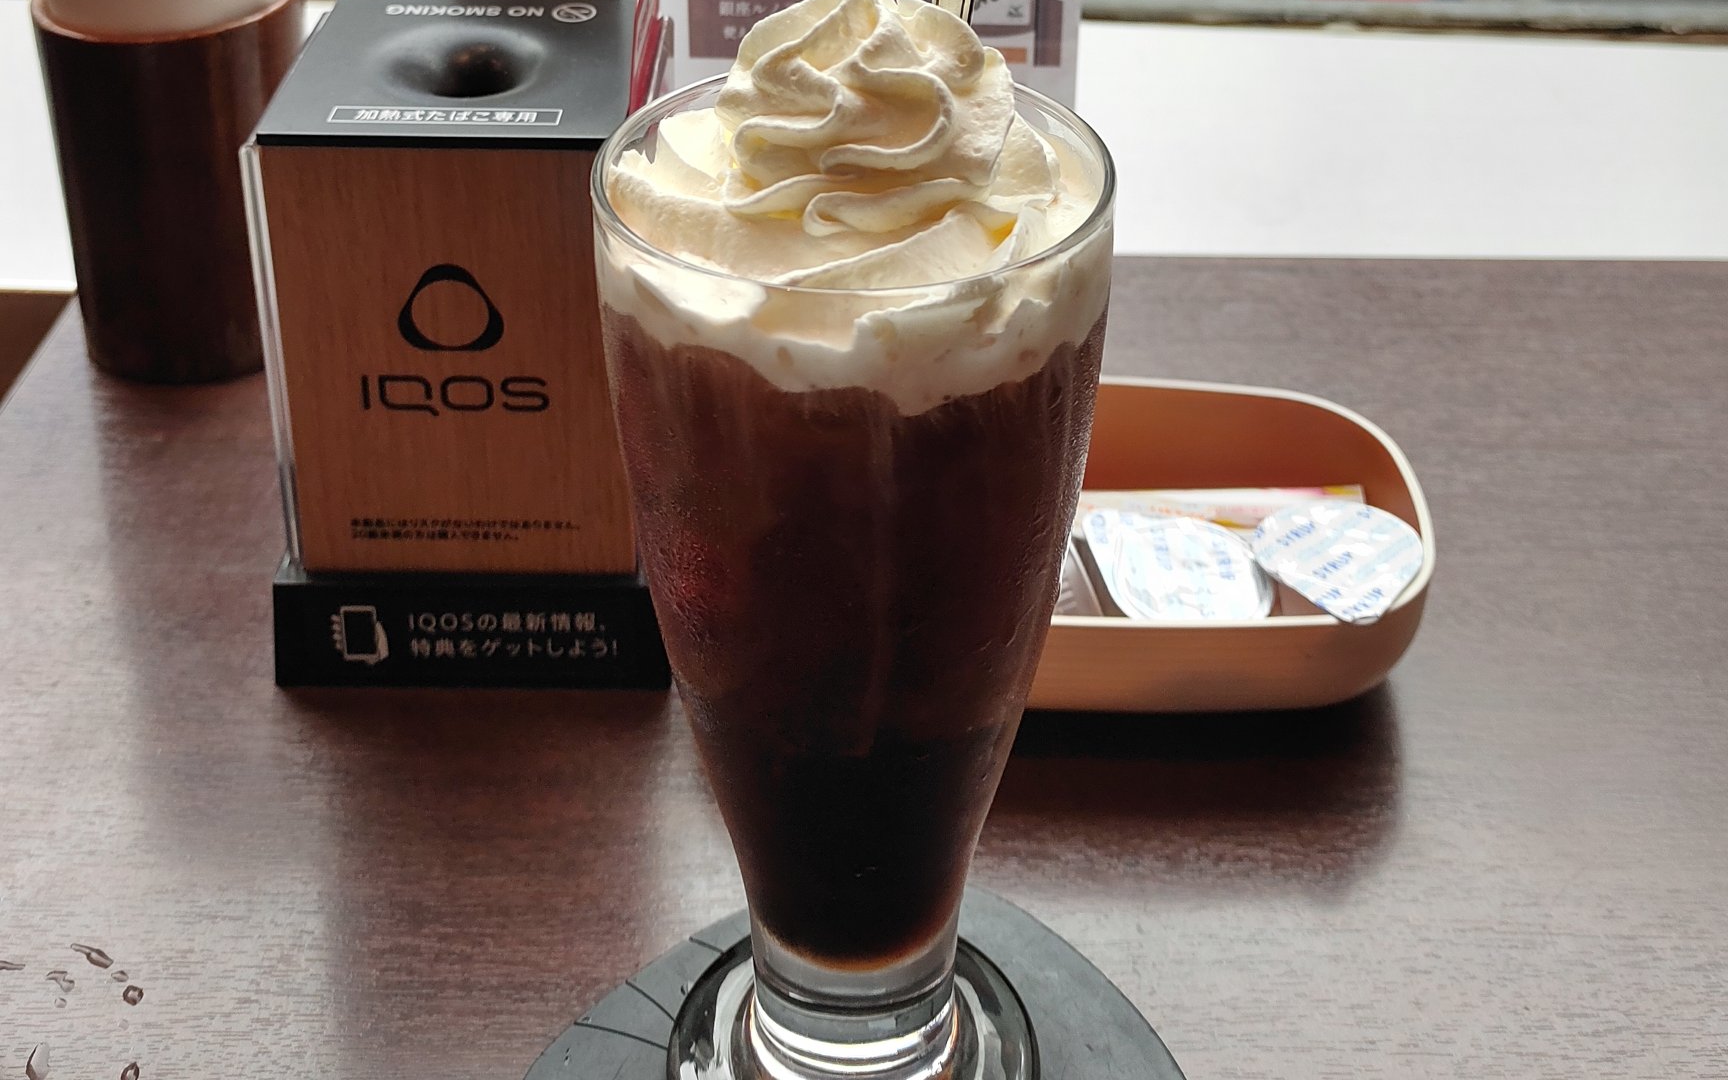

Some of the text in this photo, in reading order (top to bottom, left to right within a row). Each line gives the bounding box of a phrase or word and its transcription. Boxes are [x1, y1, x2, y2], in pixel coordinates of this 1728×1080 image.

[385, 4, 545, 18] NO SMOKING
[354, 108, 538, 123] 加熱式たばこ専用
[361, 374, 549, 416] IQOS
